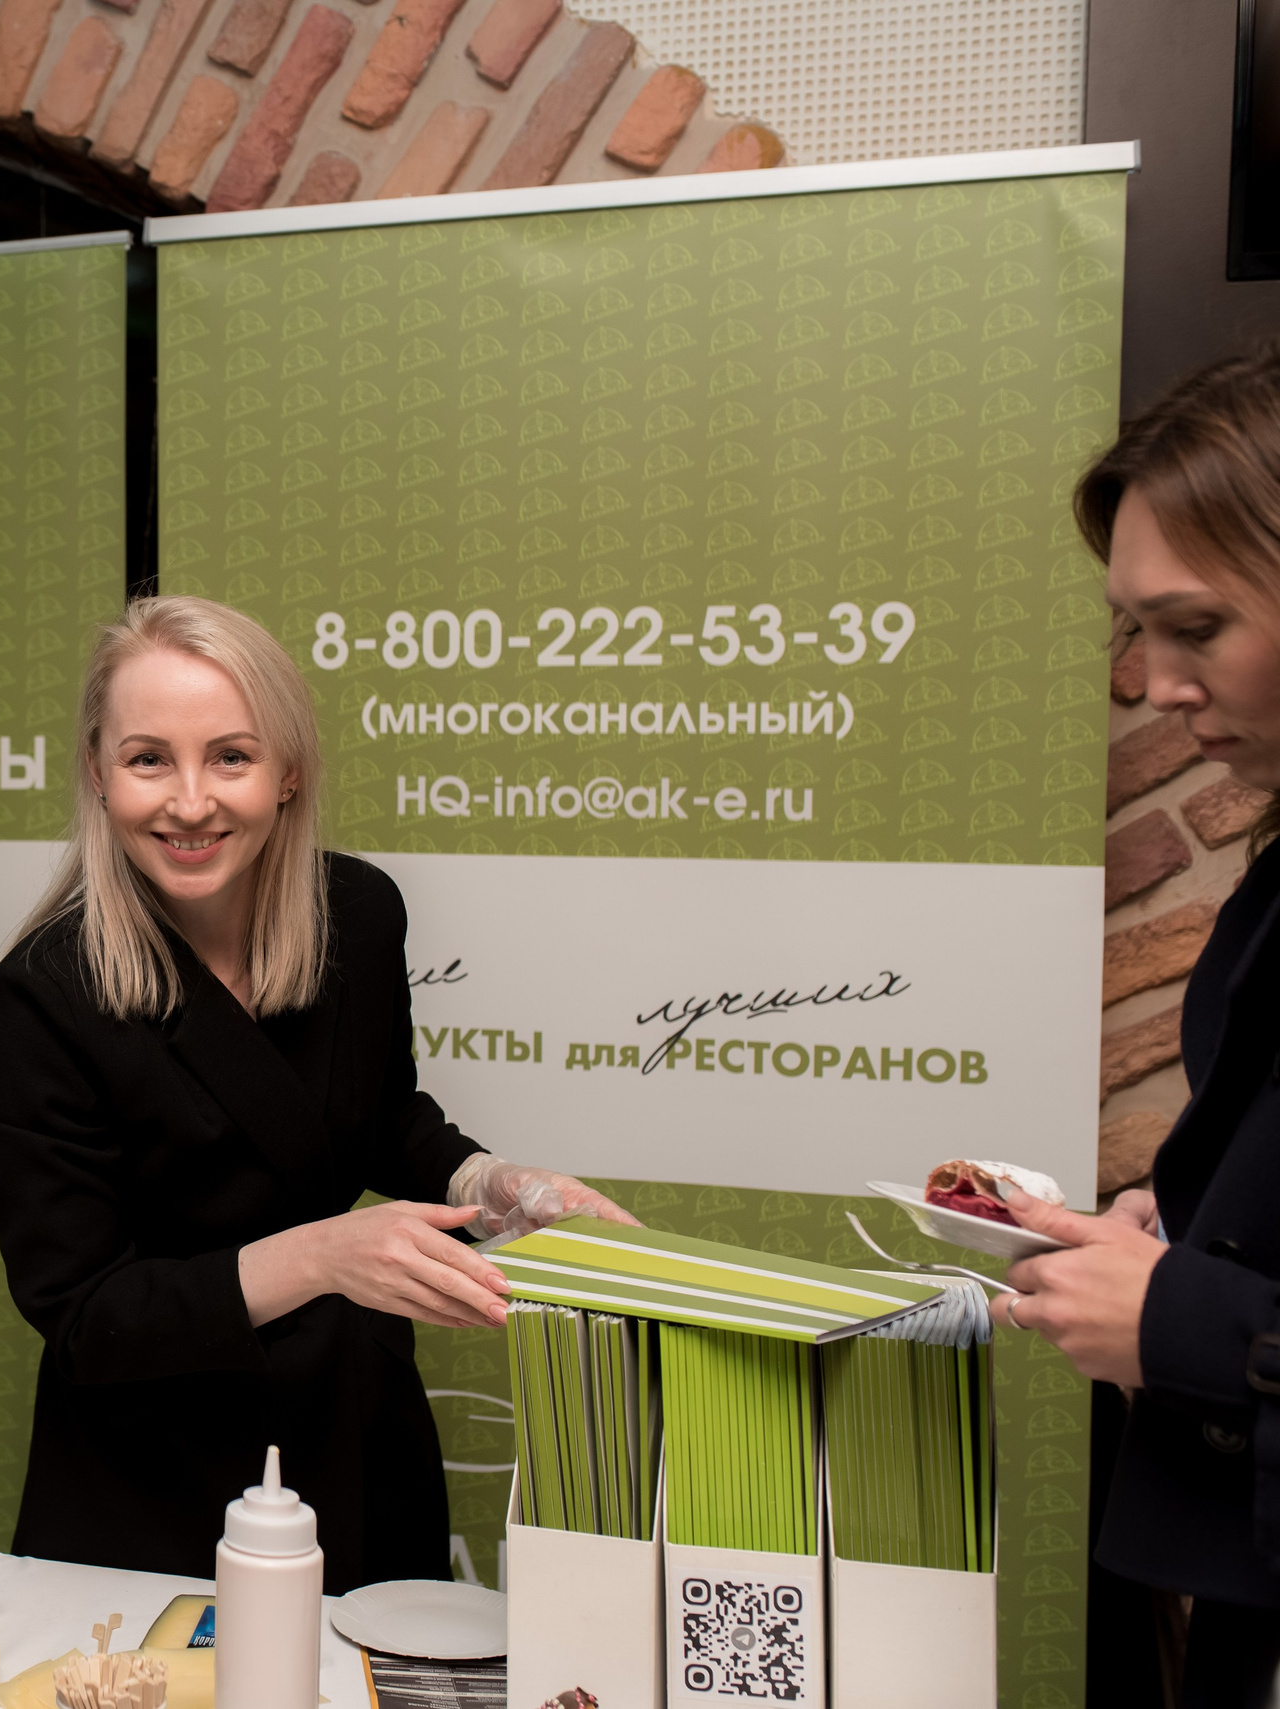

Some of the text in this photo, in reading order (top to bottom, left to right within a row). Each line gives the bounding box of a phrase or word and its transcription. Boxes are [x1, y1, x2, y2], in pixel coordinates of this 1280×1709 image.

[312, 602, 916, 670] 8-800-222-53-39
[360, 691, 855, 740] (многоканальный)
[396, 776, 814, 822] HQ-info@ak-e.ru
[412, 1025, 989, 1085] УКТЫ для РЕСТОРАНОВ
